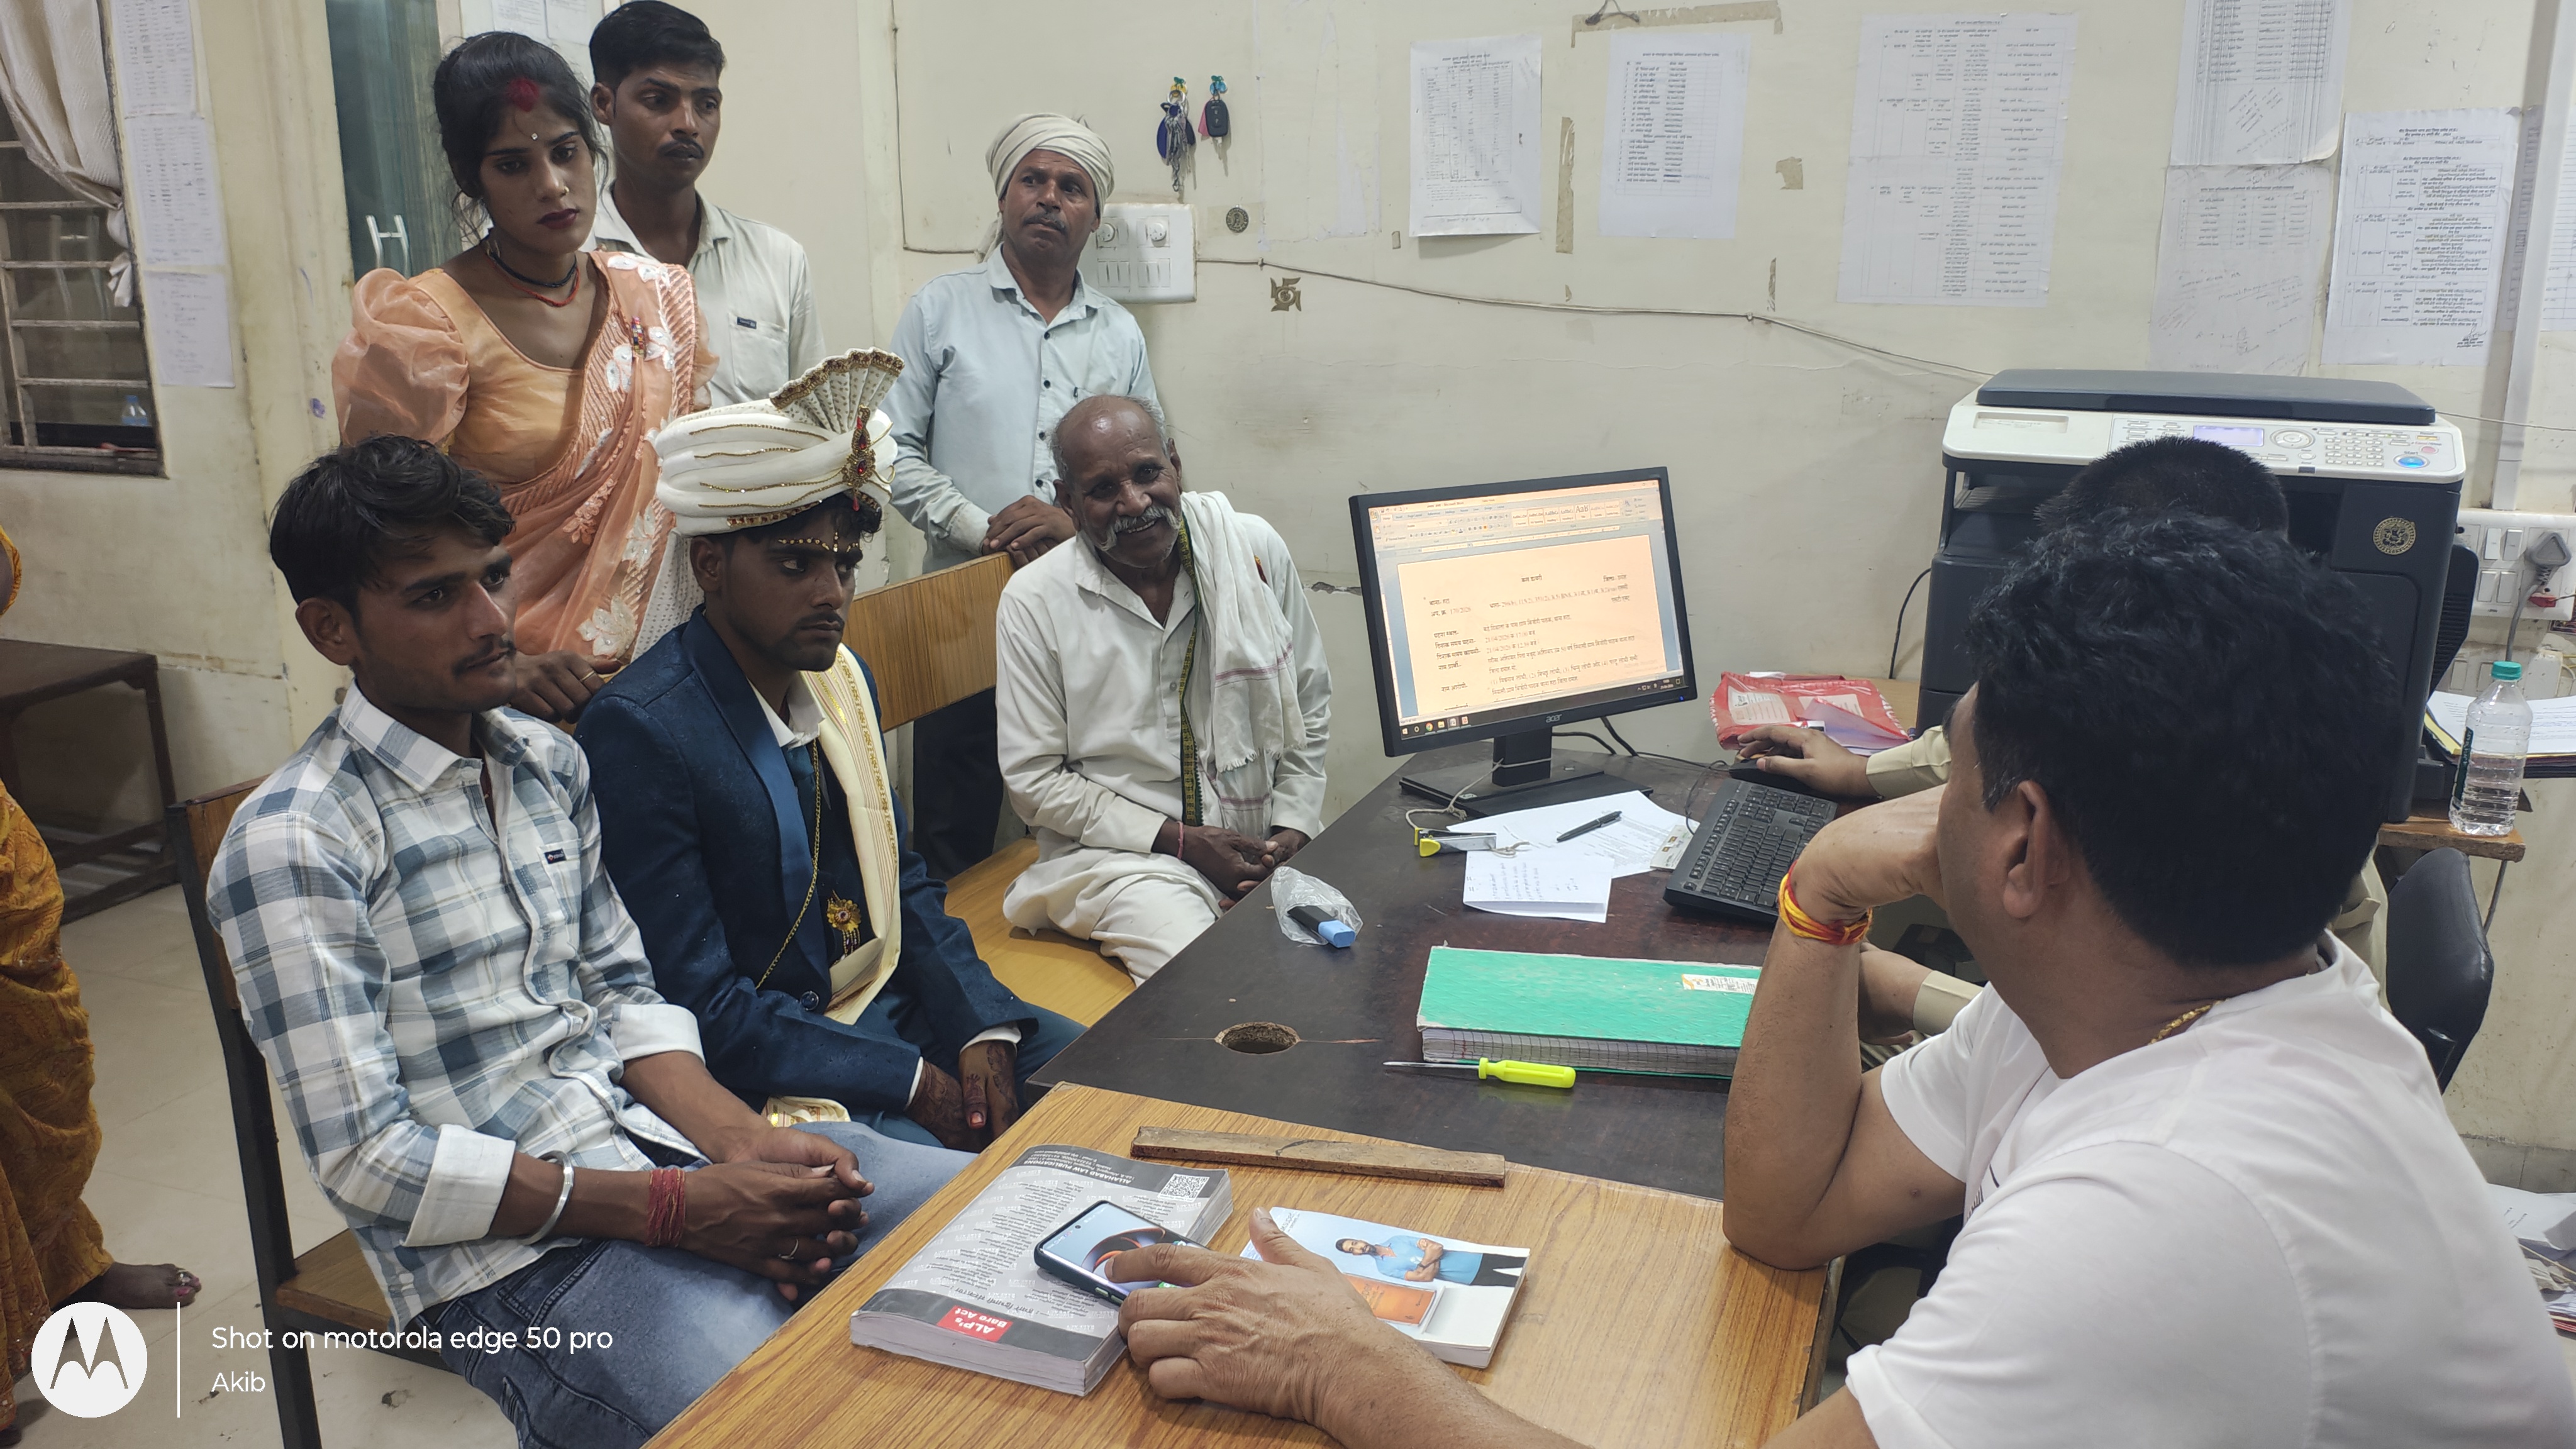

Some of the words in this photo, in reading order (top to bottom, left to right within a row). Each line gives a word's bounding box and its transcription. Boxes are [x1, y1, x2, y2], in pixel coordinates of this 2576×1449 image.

[1545, 713, 1562, 723] acer
[1090, 1171, 1132, 1184] ALLAHABAD
[954, 1307, 978, 1319] Act
[955, 1317, 996, 1334] ALP's
[979, 1315, 1008, 1328] Bare
